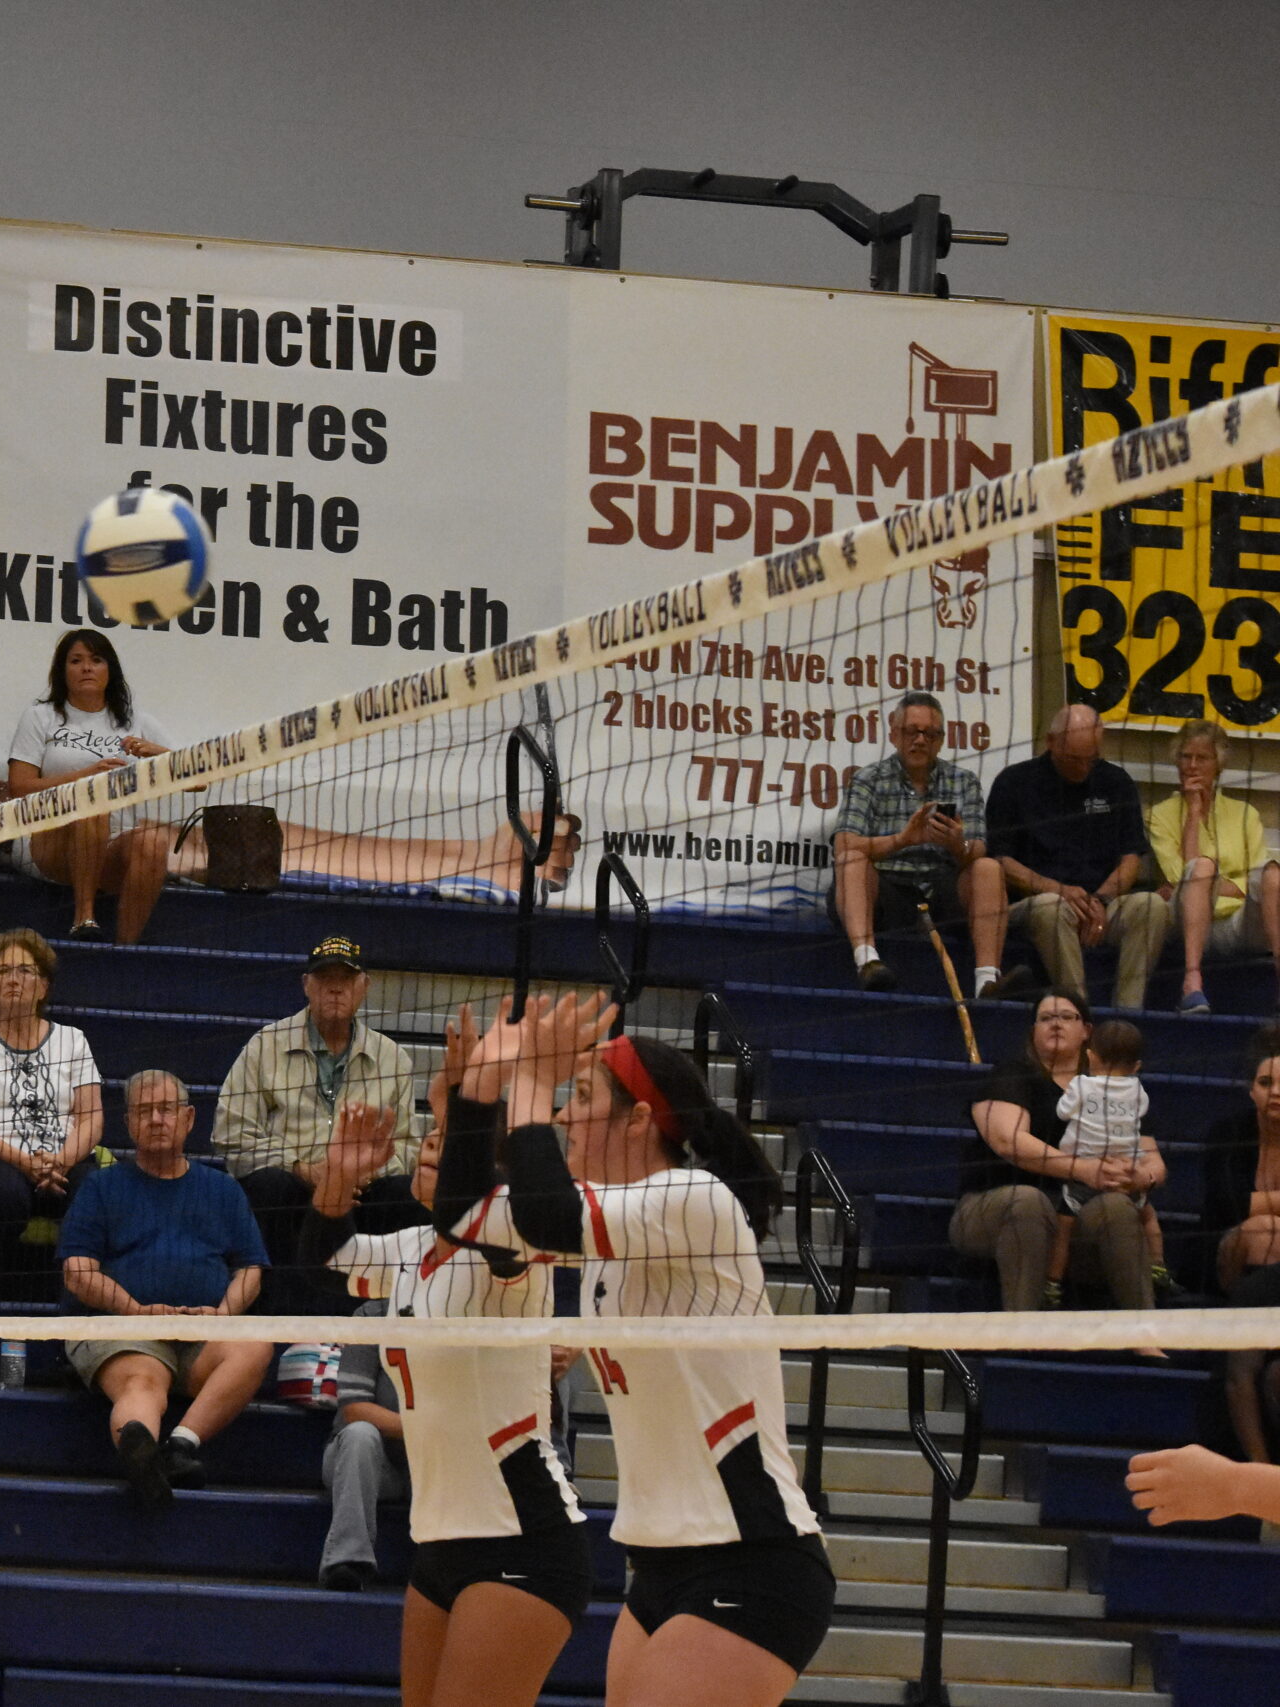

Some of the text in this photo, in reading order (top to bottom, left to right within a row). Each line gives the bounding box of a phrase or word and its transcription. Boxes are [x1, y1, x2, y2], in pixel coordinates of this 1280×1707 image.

[53, 284, 437, 377] Distinctive
[104, 377, 389, 465] Fixtures
[588, 410, 1012, 498] BENJAMIN
[246, 481, 360, 554] the
[883, 469, 1037, 557] VOLLEYBALL
[281, 584, 330, 644] &
[350, 578, 509, 654] Bath
[671, 640, 692, 675] N
[701, 640, 753, 679] 7th
[762, 645, 834, 685] Ave.
[843, 653, 879, 688] at
[887, 653, 945, 693] 6th
[955, 657, 1001, 696] St.
[603, 690, 623, 727] 2
[633, 693, 752, 735] blocks
[762, 702, 836, 741] East
[845, 710, 880, 744] of
